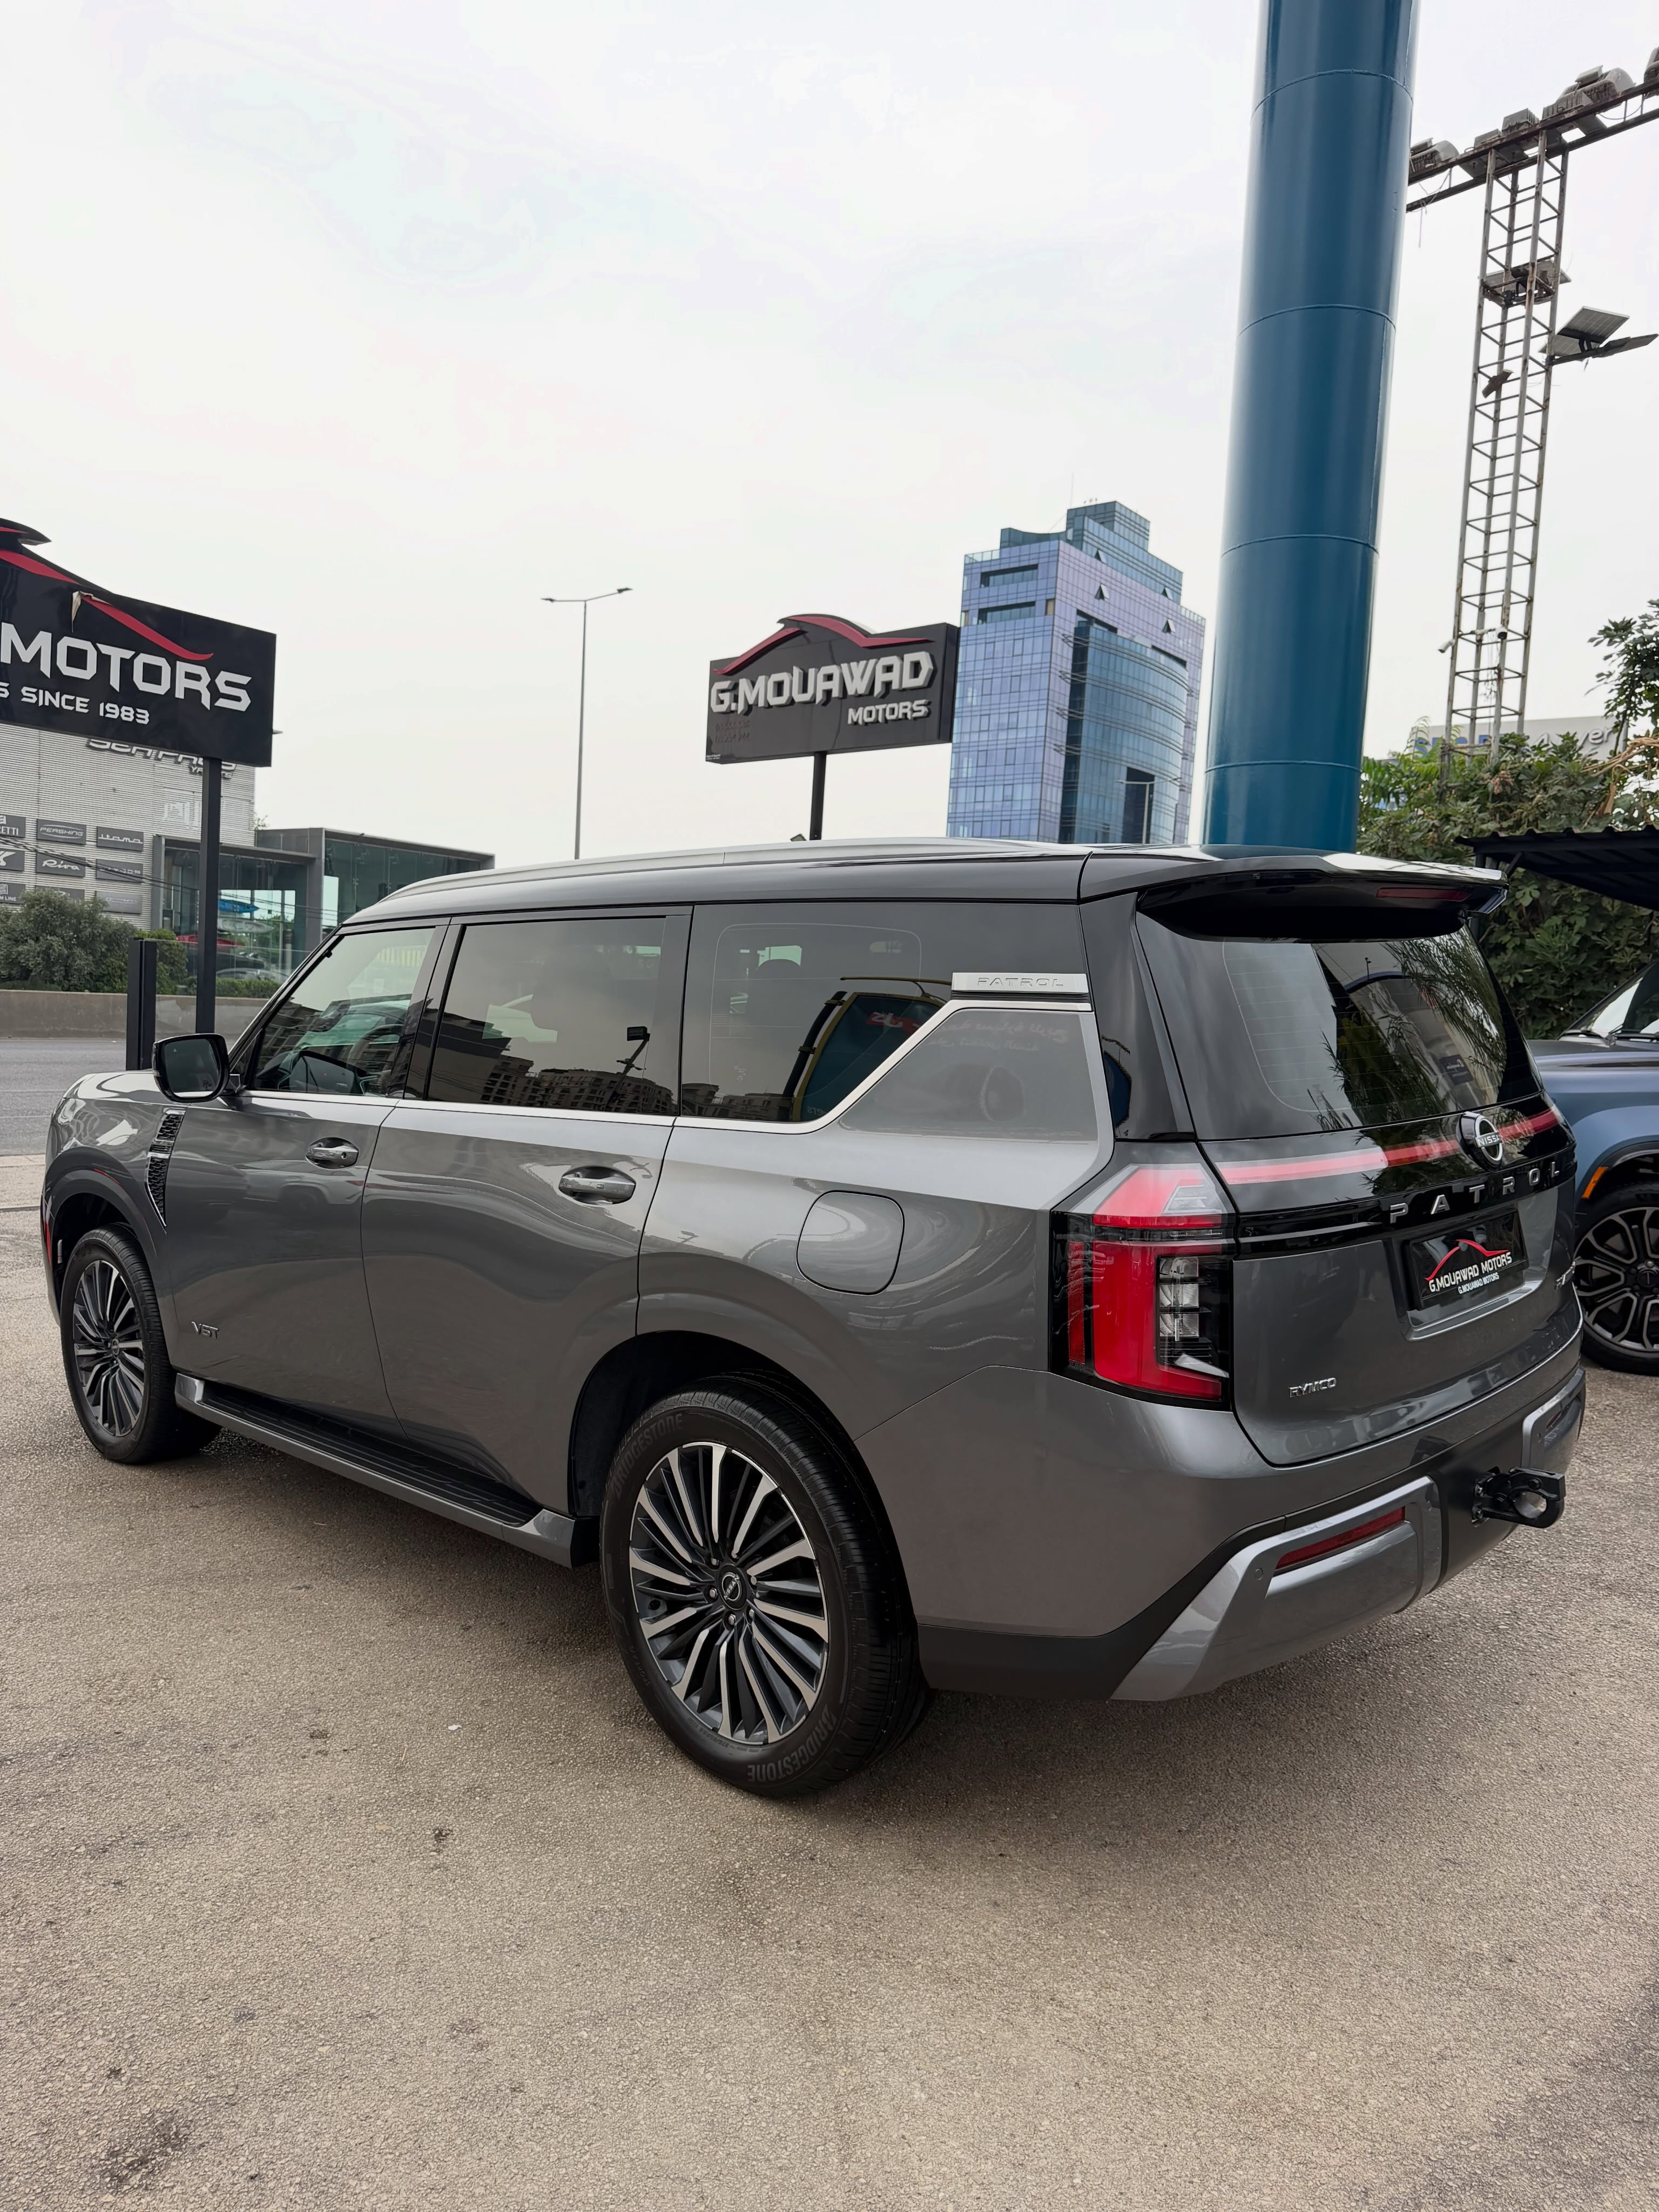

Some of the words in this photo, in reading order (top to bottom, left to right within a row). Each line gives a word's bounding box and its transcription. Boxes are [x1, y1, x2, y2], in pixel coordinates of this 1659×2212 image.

[0, 622, 252, 712] MOTORS
[710, 651, 934, 715] G.MOUAWAD
[21, 685, 90, 713] SINCE
[99, 702, 150, 725] 1983
[847, 699, 930, 725] MOTORS
[42, 859, 80, 871] Riva
[977, 977, 1064, 988] PATROL
[1390, 1161, 1560, 1224] PATROL
[1428, 1264, 1479, 1293] G.MOUAWAD
[1481, 1251, 1512, 1274] MOTORS
[1483, 1272, 1500, 1285] MOTORS
[723, 1573, 740, 1601] NISSAN
[747, 1703, 838, 1782] BRIDGESTONE
